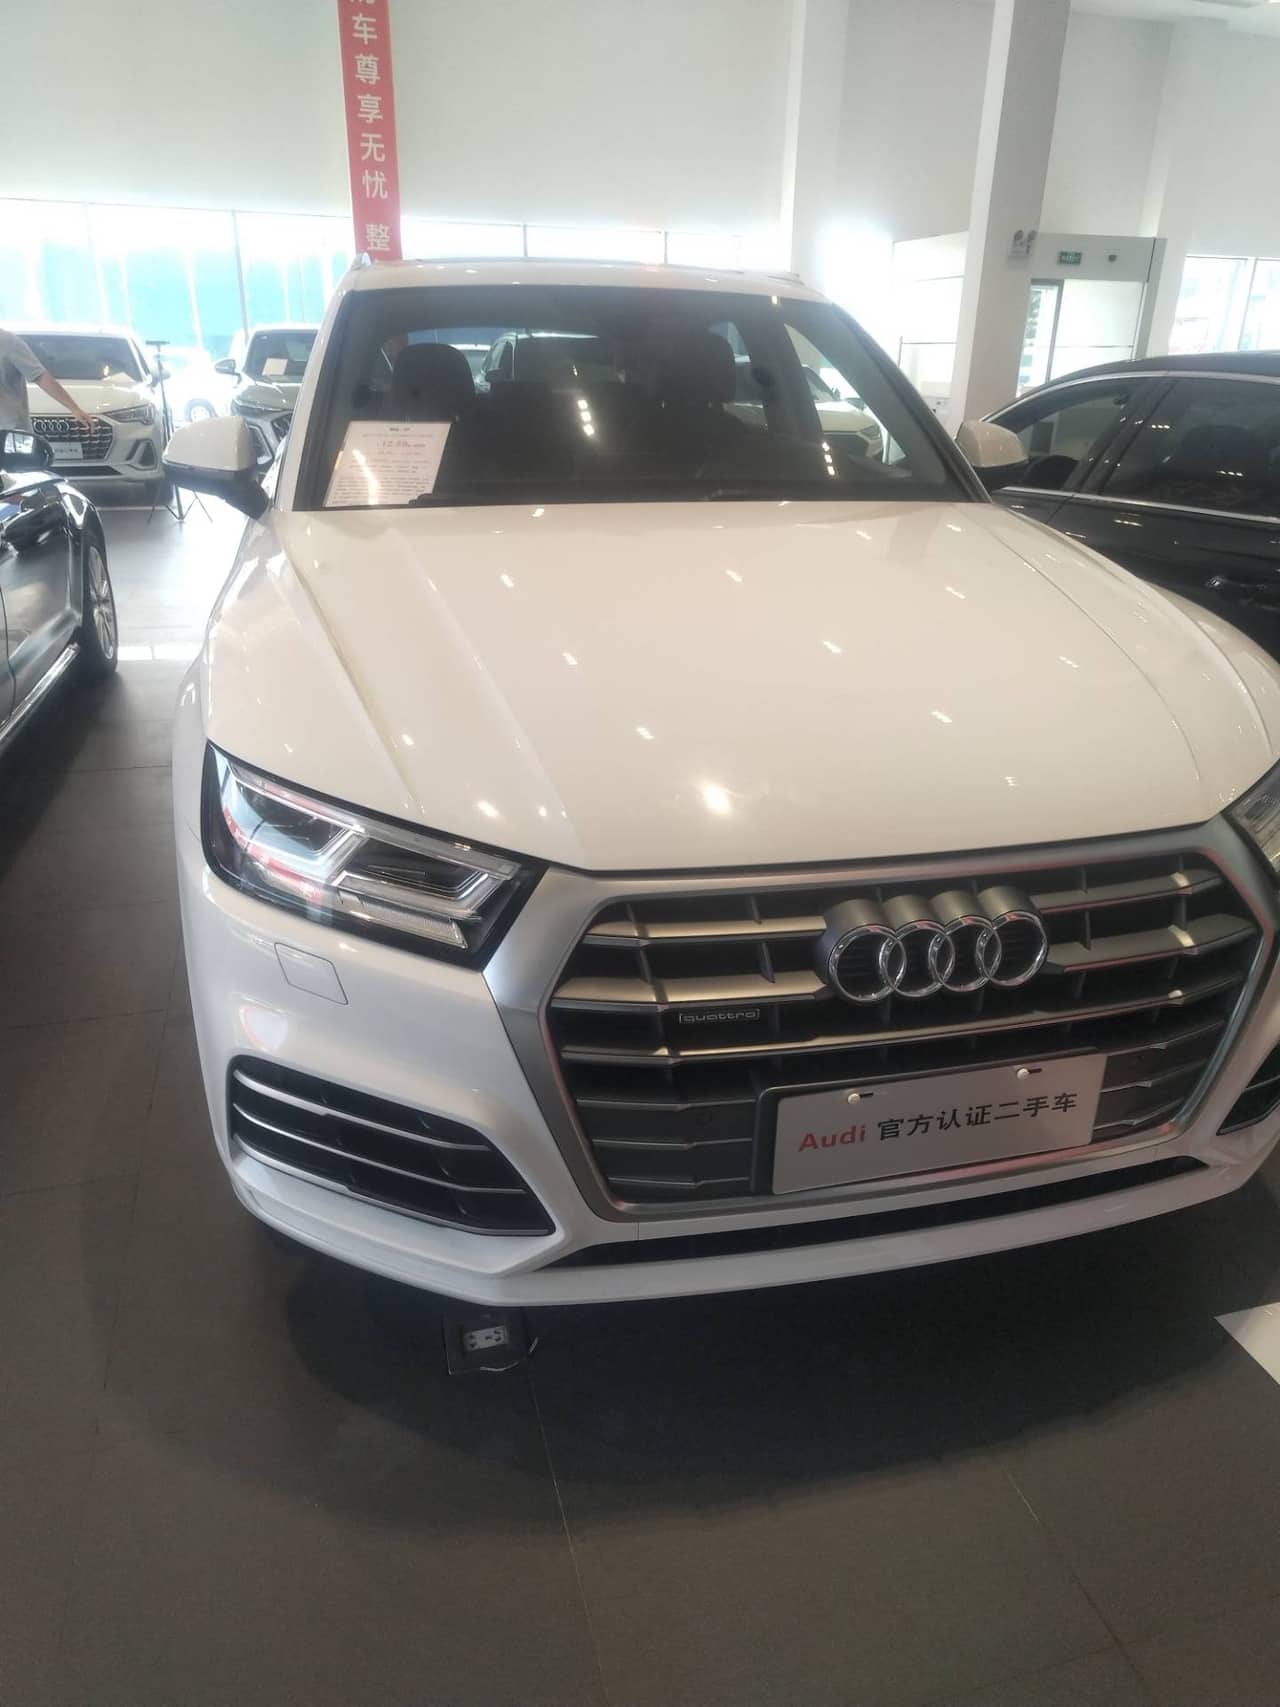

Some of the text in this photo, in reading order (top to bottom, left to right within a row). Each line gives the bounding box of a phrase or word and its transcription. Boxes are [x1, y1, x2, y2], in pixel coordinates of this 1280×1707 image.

[350, 0, 391, 251] 车尊享无忧 整
[682, 1008, 756, 1024] quattro
[798, 1093, 1078, 1152] Audi 官方认证二手车
